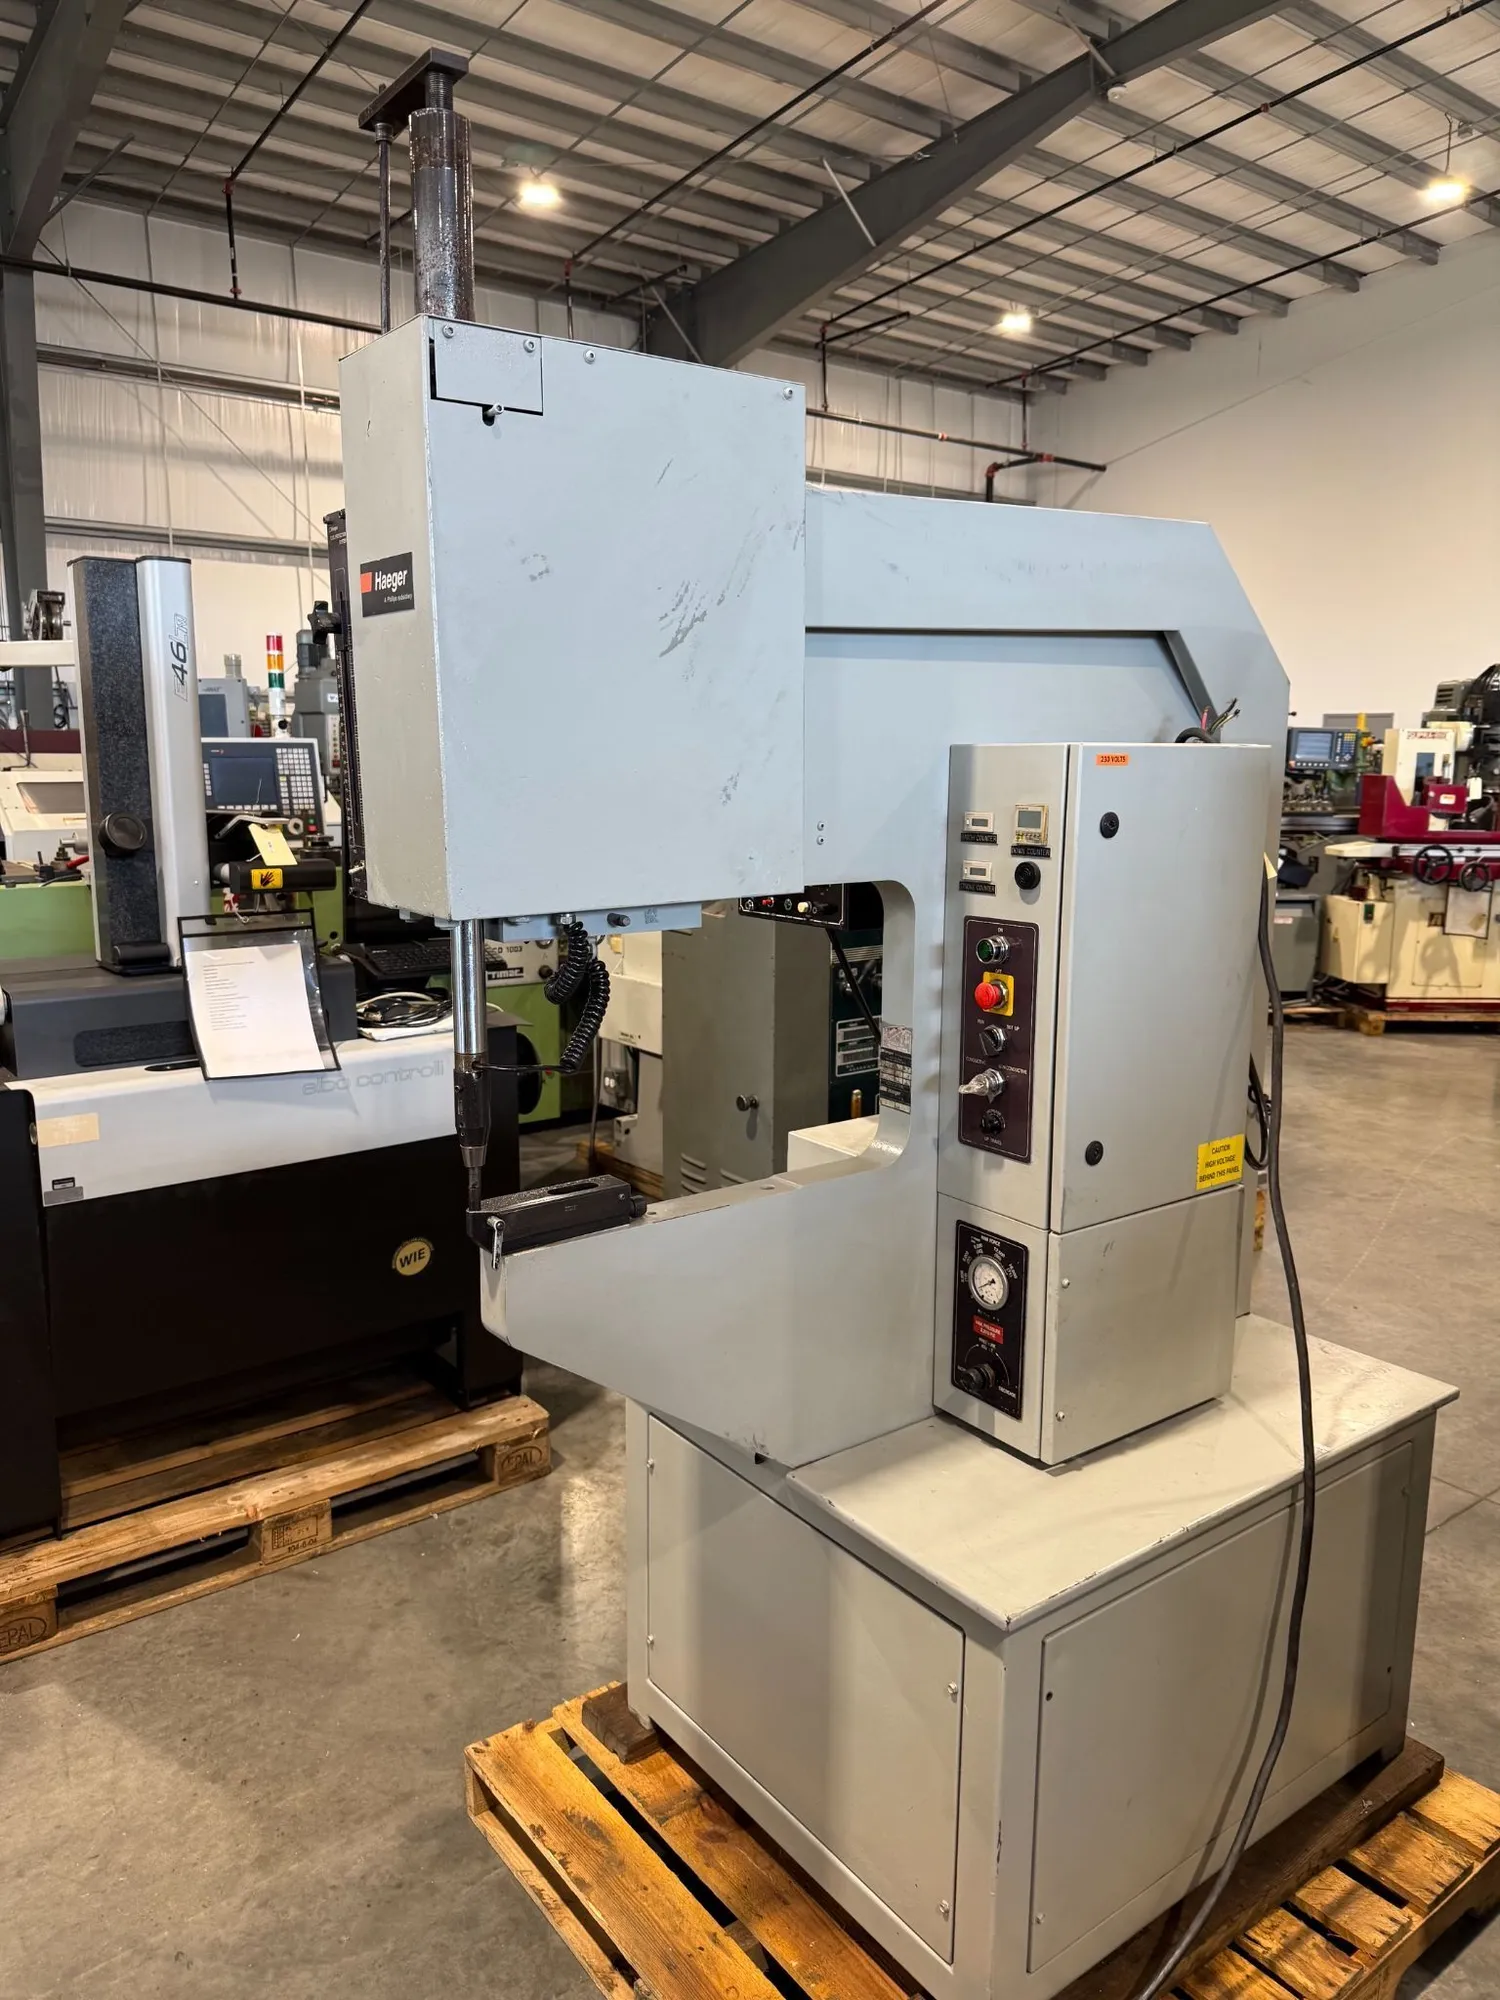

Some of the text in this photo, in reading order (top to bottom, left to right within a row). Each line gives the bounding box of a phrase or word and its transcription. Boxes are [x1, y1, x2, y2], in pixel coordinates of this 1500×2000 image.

[374, 570, 408, 592] Haeger
[1027, 847, 1050, 857] COUNTER
[356, 1060, 444, 1088] controlli
[1211, 1143, 1231, 1155] CAUTION
[1217, 1154, 1236, 1165] VOLTAGE
[1198, 1165, 1240, 1183] BEHIND THIS PANEL
[400, 1247, 426, 1269] WIE
